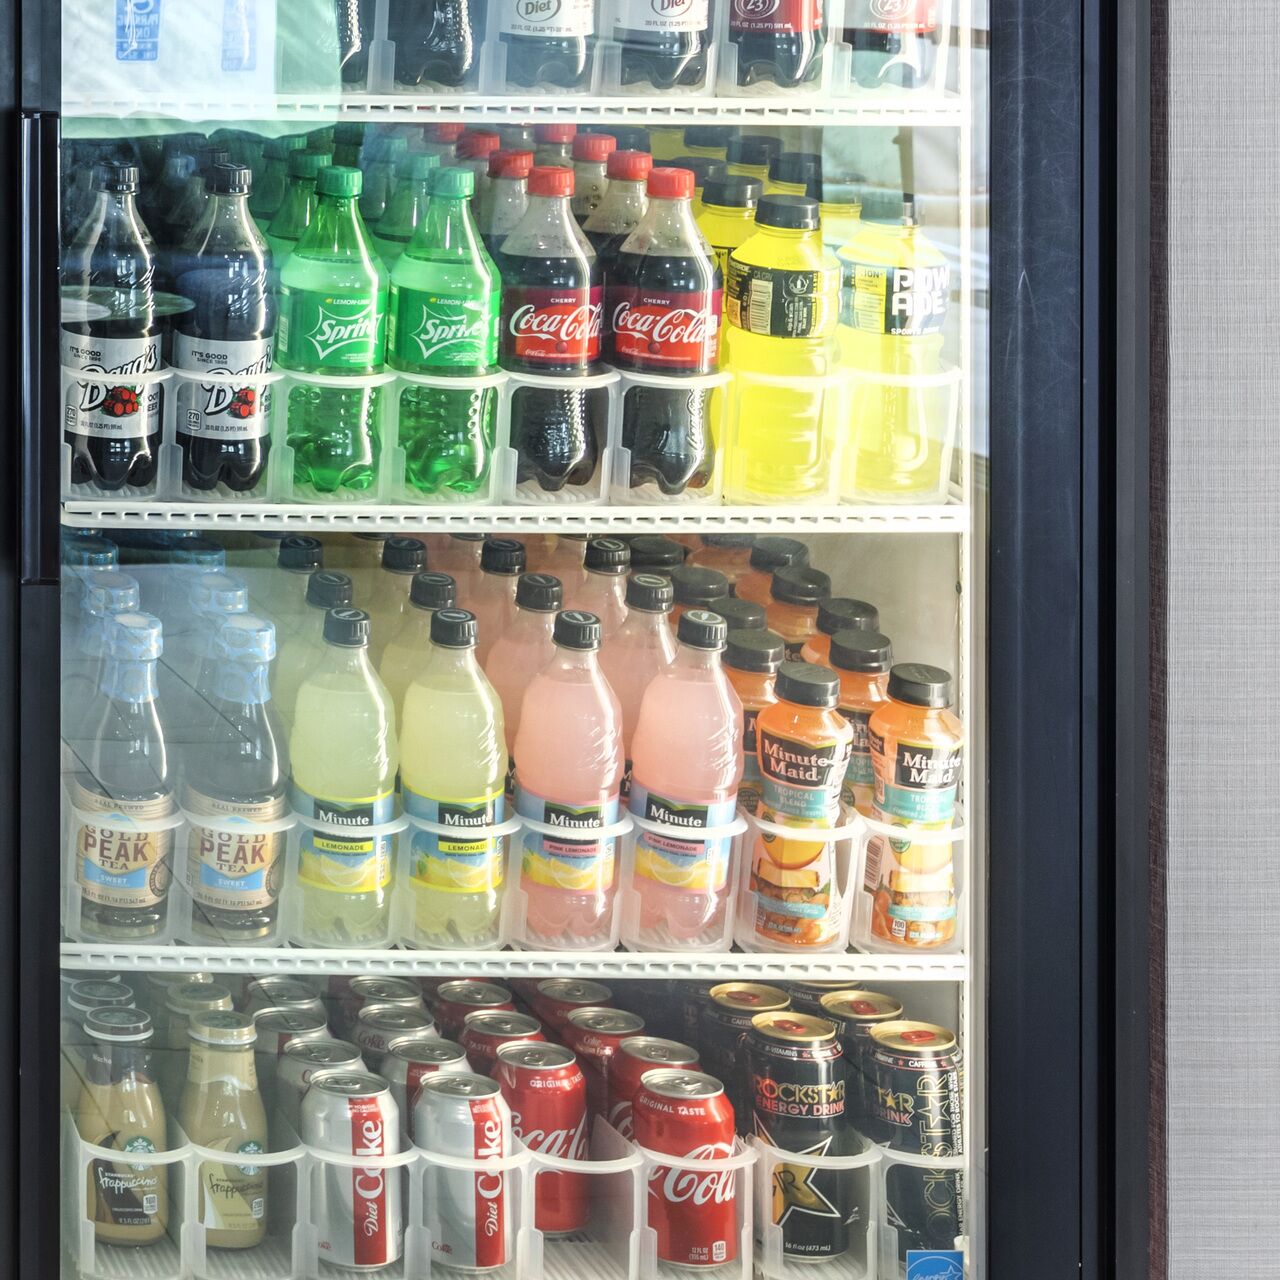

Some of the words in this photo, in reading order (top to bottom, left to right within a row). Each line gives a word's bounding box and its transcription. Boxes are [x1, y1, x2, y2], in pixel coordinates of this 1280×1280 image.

[525, 0, 551, 16] Diet
[643, 297, 670, 305] CHERRY
[509, 302, 601, 341] Coca-Cola
[612, 302, 709, 344] Coca-Cola
[316, 318, 378, 344] Sprite
[80, 349, 102, 357] GOOD
[188, 411, 200, 421] 270
[764, 739, 828, 767] Minute
[902, 752, 961, 769] Minute
[770, 760, 821, 781] Maid
[909, 769, 954, 784] Maid
[319, 810, 370, 826] Minute
[444, 813, 493, 827] Minute
[549, 813, 600, 828] Minute
[650, 805, 702, 827] Minute
[84, 832, 151, 863] PEAK
[200, 836, 268, 865] PEAK
[322, 842, 364, 851] LEMONADE
[663, 841, 697, 852] LEMONADE
[99, 859, 129, 870] TEA
[216, 863, 248, 873] TEA
[100, 874, 128, 884] SWEET
[218, 878, 246, 886] SWEET
[639, 1095, 674, 1114] ORIGINAL
[677, 1106, 706, 1117] TASTE
[756, 1097, 809, 1114] ENERGY
[813, 1101, 845, 1116] DRINK
[98, 1167, 158, 1194] frappuccino
[363, 1201, 379, 1237] Diet
[485, 1201, 498, 1237] Diet
